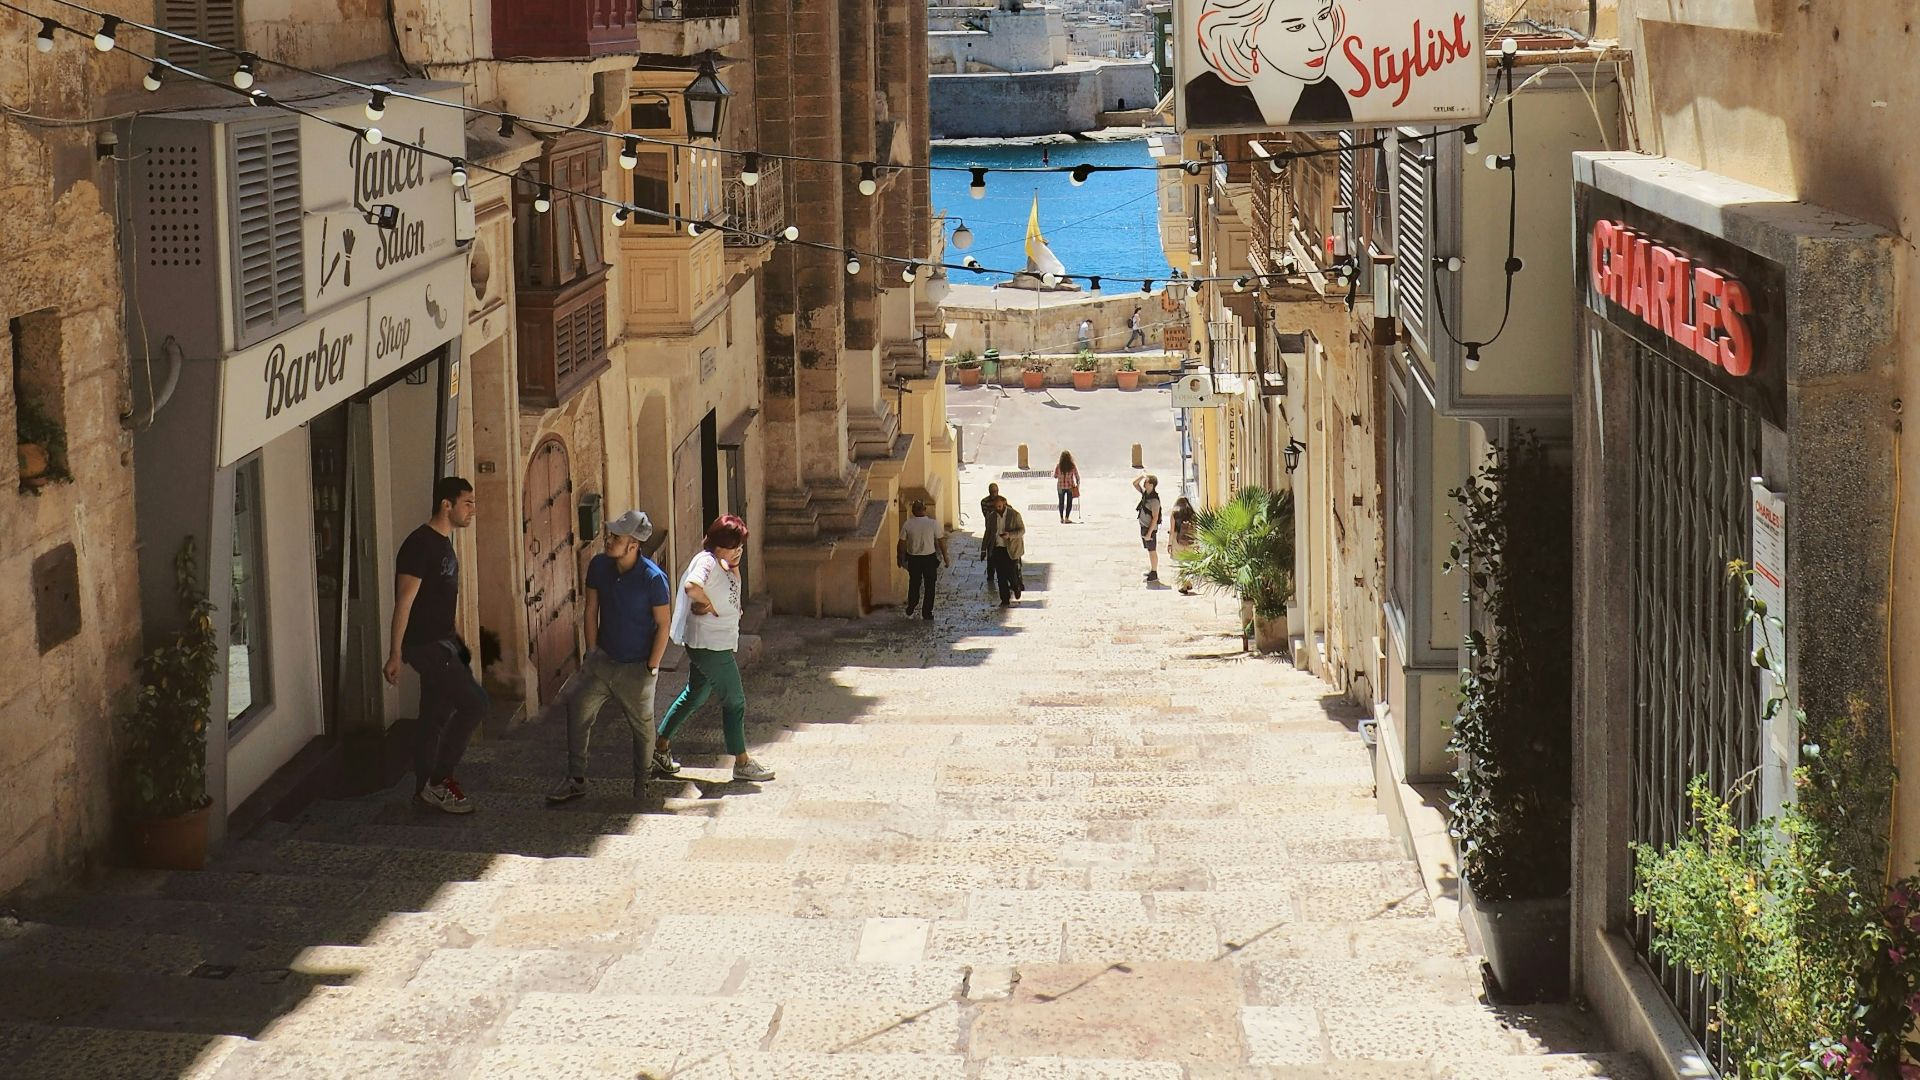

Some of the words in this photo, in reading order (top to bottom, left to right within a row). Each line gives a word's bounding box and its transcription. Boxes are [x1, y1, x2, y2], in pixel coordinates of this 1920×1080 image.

[1342, 11, 1472, 108] Stylist
[348, 126, 426, 208] Lancet
[375, 211, 425, 270] Salon
[1590, 219, 1753, 377] CHARLES
[264, 326, 354, 420] Barber
[376, 314, 411, 361] Shop
